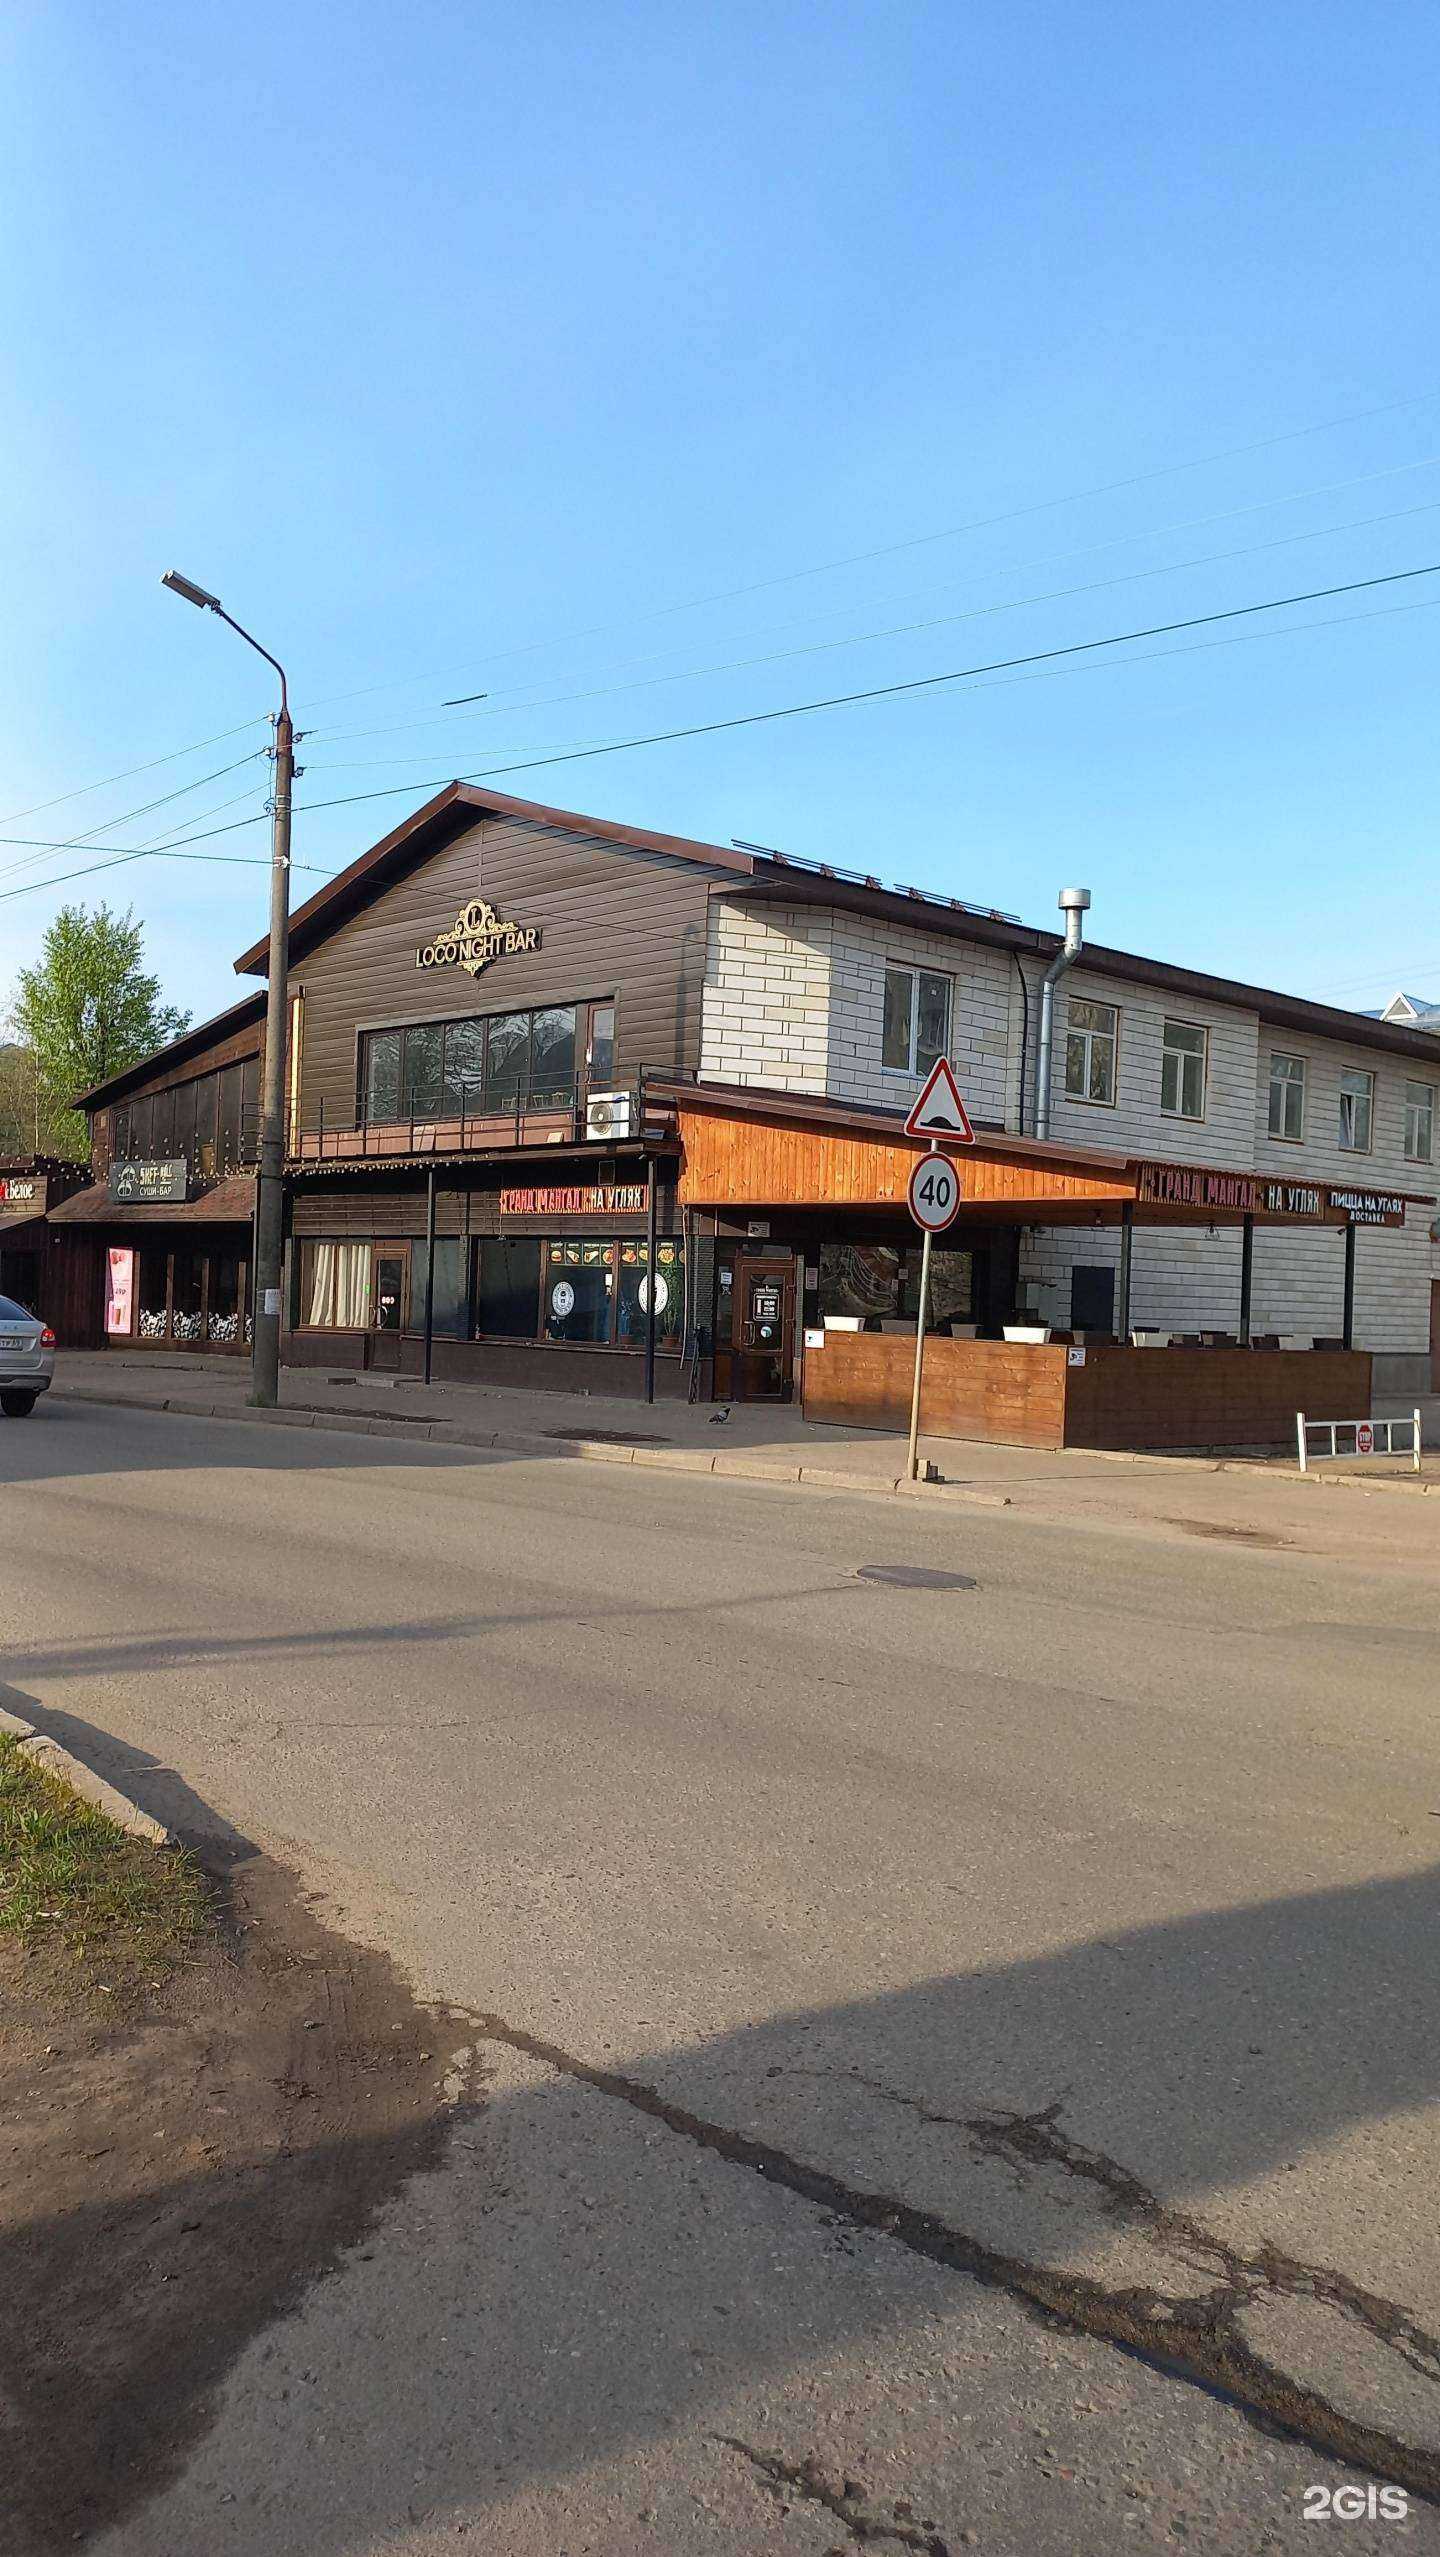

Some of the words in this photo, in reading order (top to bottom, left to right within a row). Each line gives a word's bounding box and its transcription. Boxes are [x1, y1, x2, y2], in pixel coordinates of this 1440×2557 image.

[416, 943, 456, 967] LOCO
[459, 934, 503, 960] NIGHT
[506, 928, 536, 953] BAR
[140, 1185, 172, 1196] СУШИ-БАР
[504, 1190, 534, 1211] ГРАНД
[538, 1188, 579, 1209] МАНГАЛ
[591, 1187, 604, 1208] НА
[608, 1187, 641, 1208] УГЛЯХ
[919, 1175, 950, 1207] 40
[1159, 1171, 1200, 1203] ГРАНД
[1208, 1177, 1256, 1208] МАНГАЛ
[1269, 1185, 1282, 1210] НА
[1289, 1188, 1319, 1213] УГЛЯХ
[1331, 1192, 1363, 1210] ПИЦЦА
[1365, 1195, 1376, 1211] НА
[1378, 1196, 1402, 1214] УГЛЯХ
[1350, 1211, 1385, 1224] ДОСТАВКА
